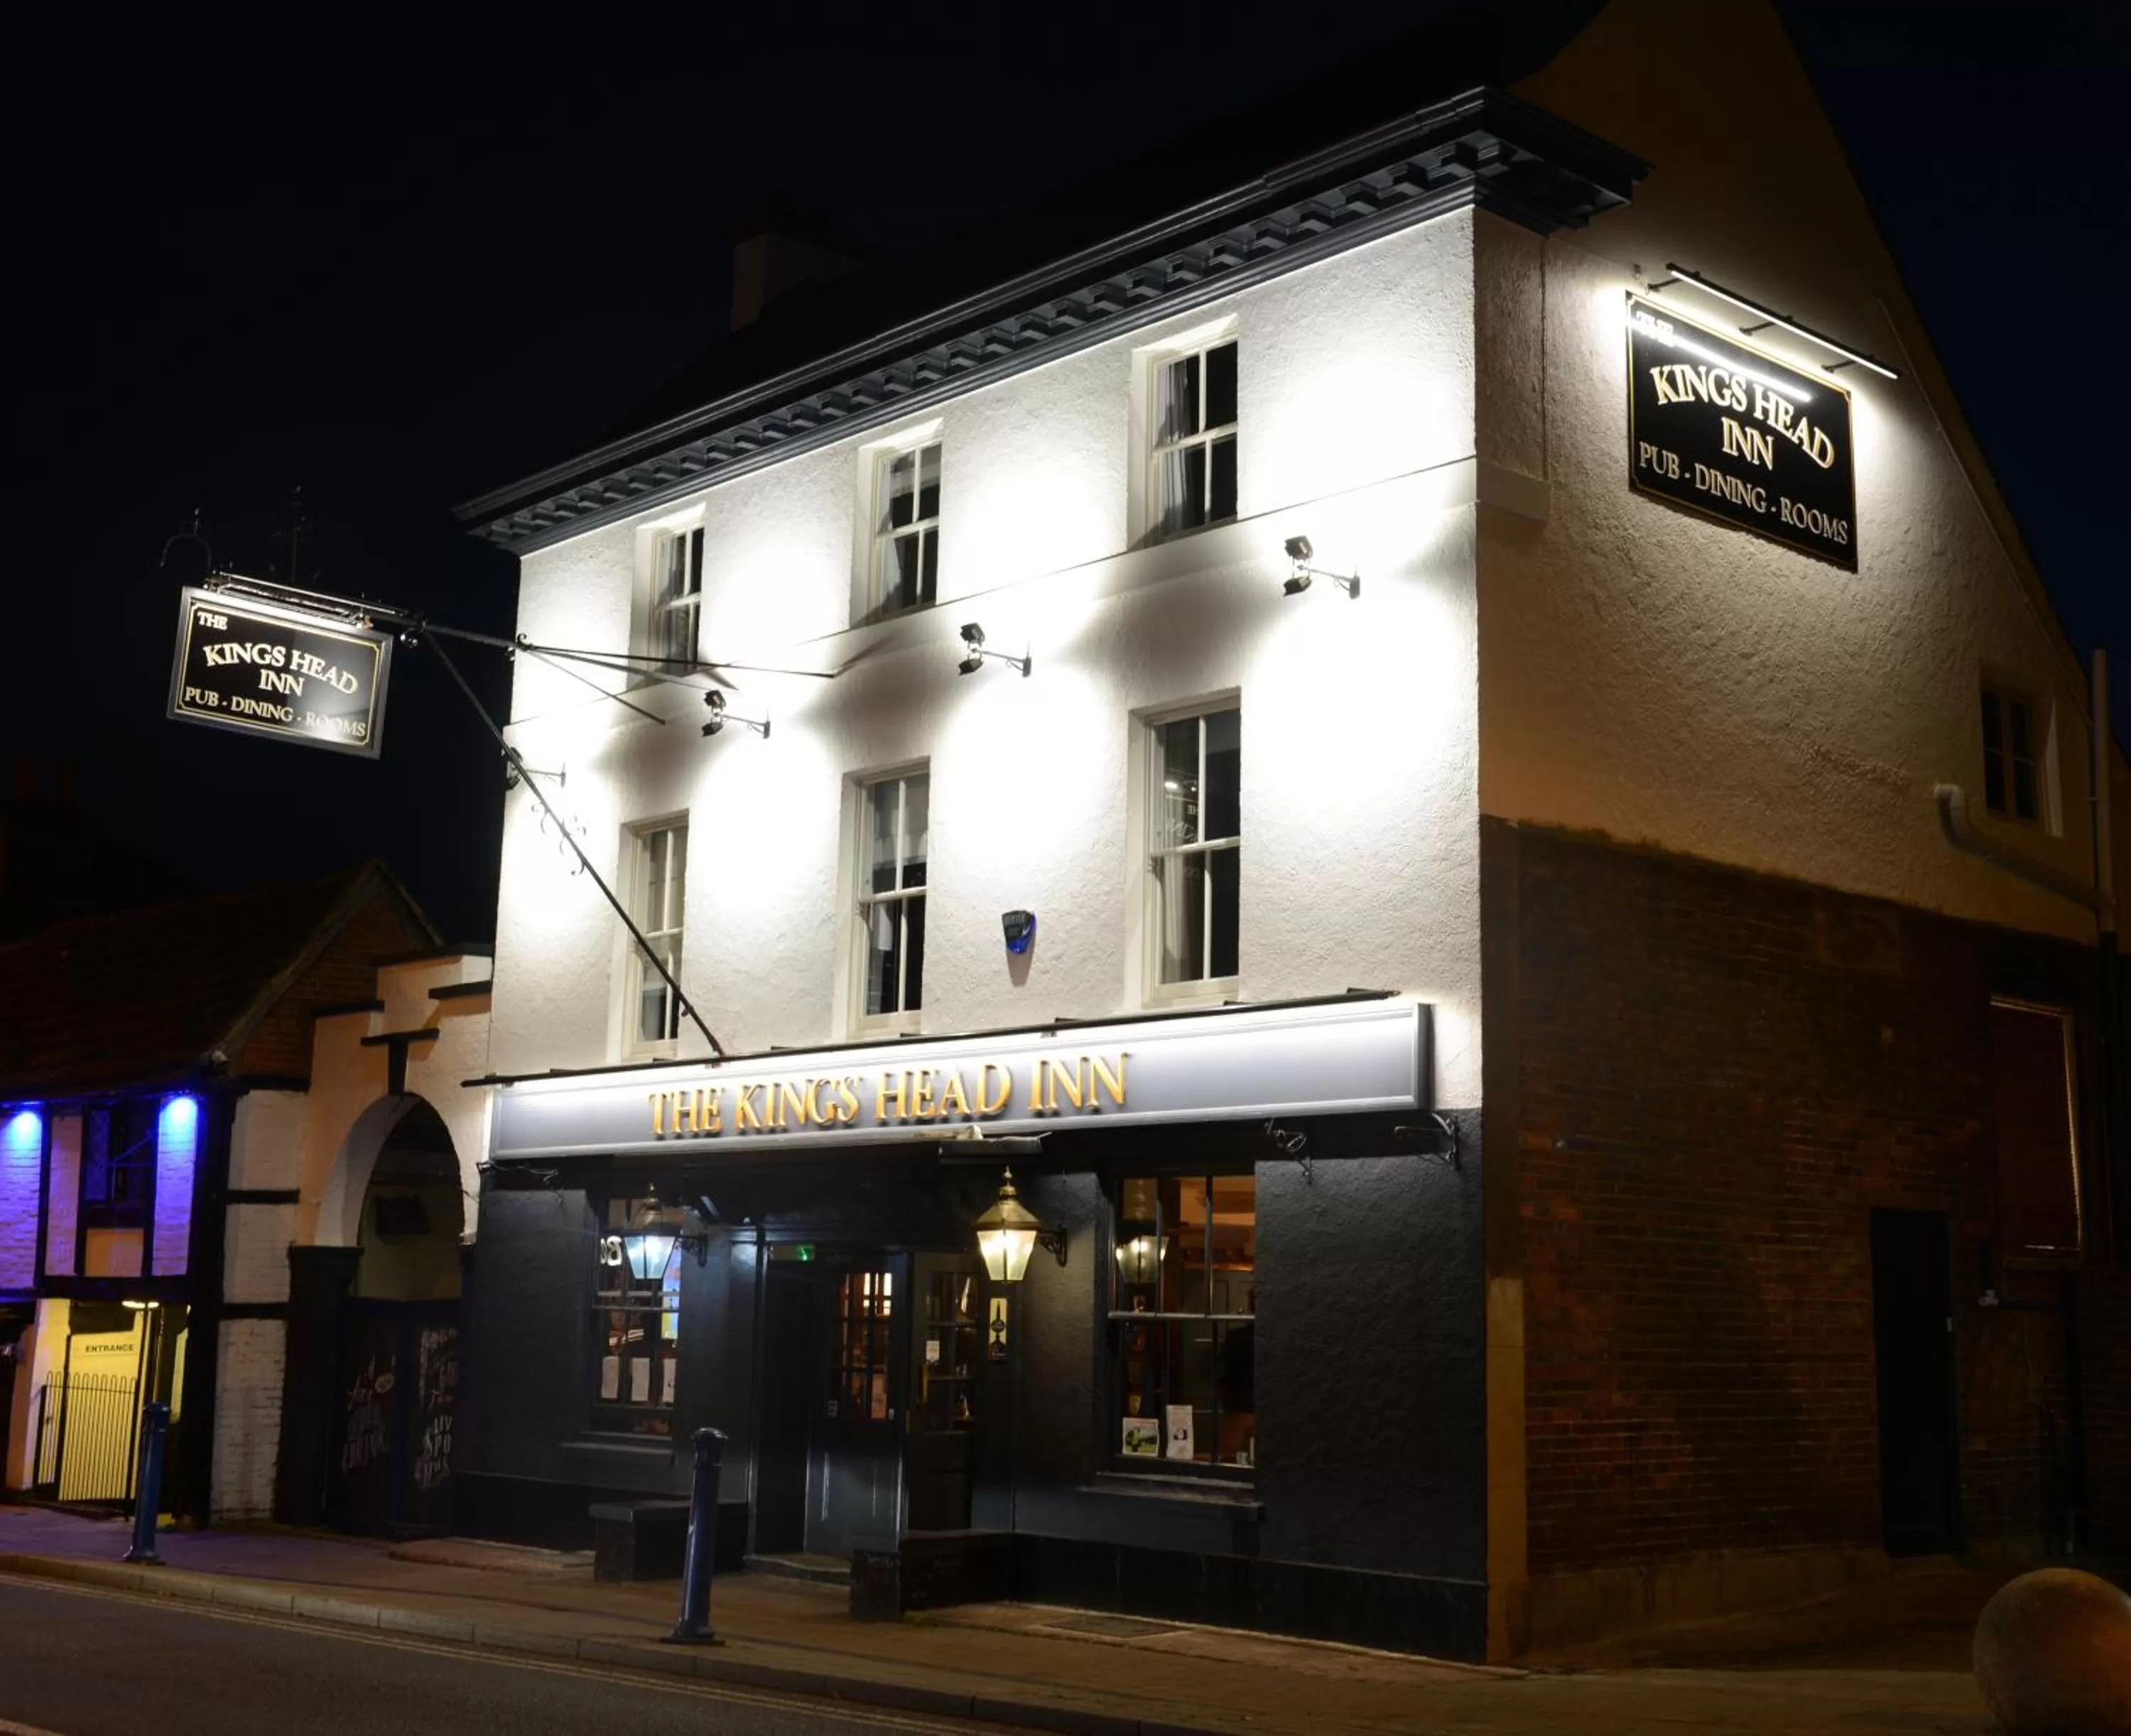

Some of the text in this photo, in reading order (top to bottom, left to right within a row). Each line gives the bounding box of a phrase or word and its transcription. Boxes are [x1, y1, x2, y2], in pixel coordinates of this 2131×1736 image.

[1649, 364, 1835, 469] KINGS HEAD
[1721, 417, 1774, 471] INN
[1639, 441, 1848, 545] PUB DINING ROOMS
[197, 611, 227, 630] THE
[203, 643, 358, 694] KINGS HEAD
[259, 669, 305, 697] INN
[185, 686, 366, 737] PUB DINING ROOMS
[647, 1052, 1132, 1136] THE KINGS HEAD INN
[85, 1343, 134, 1353] ENTRANCE
